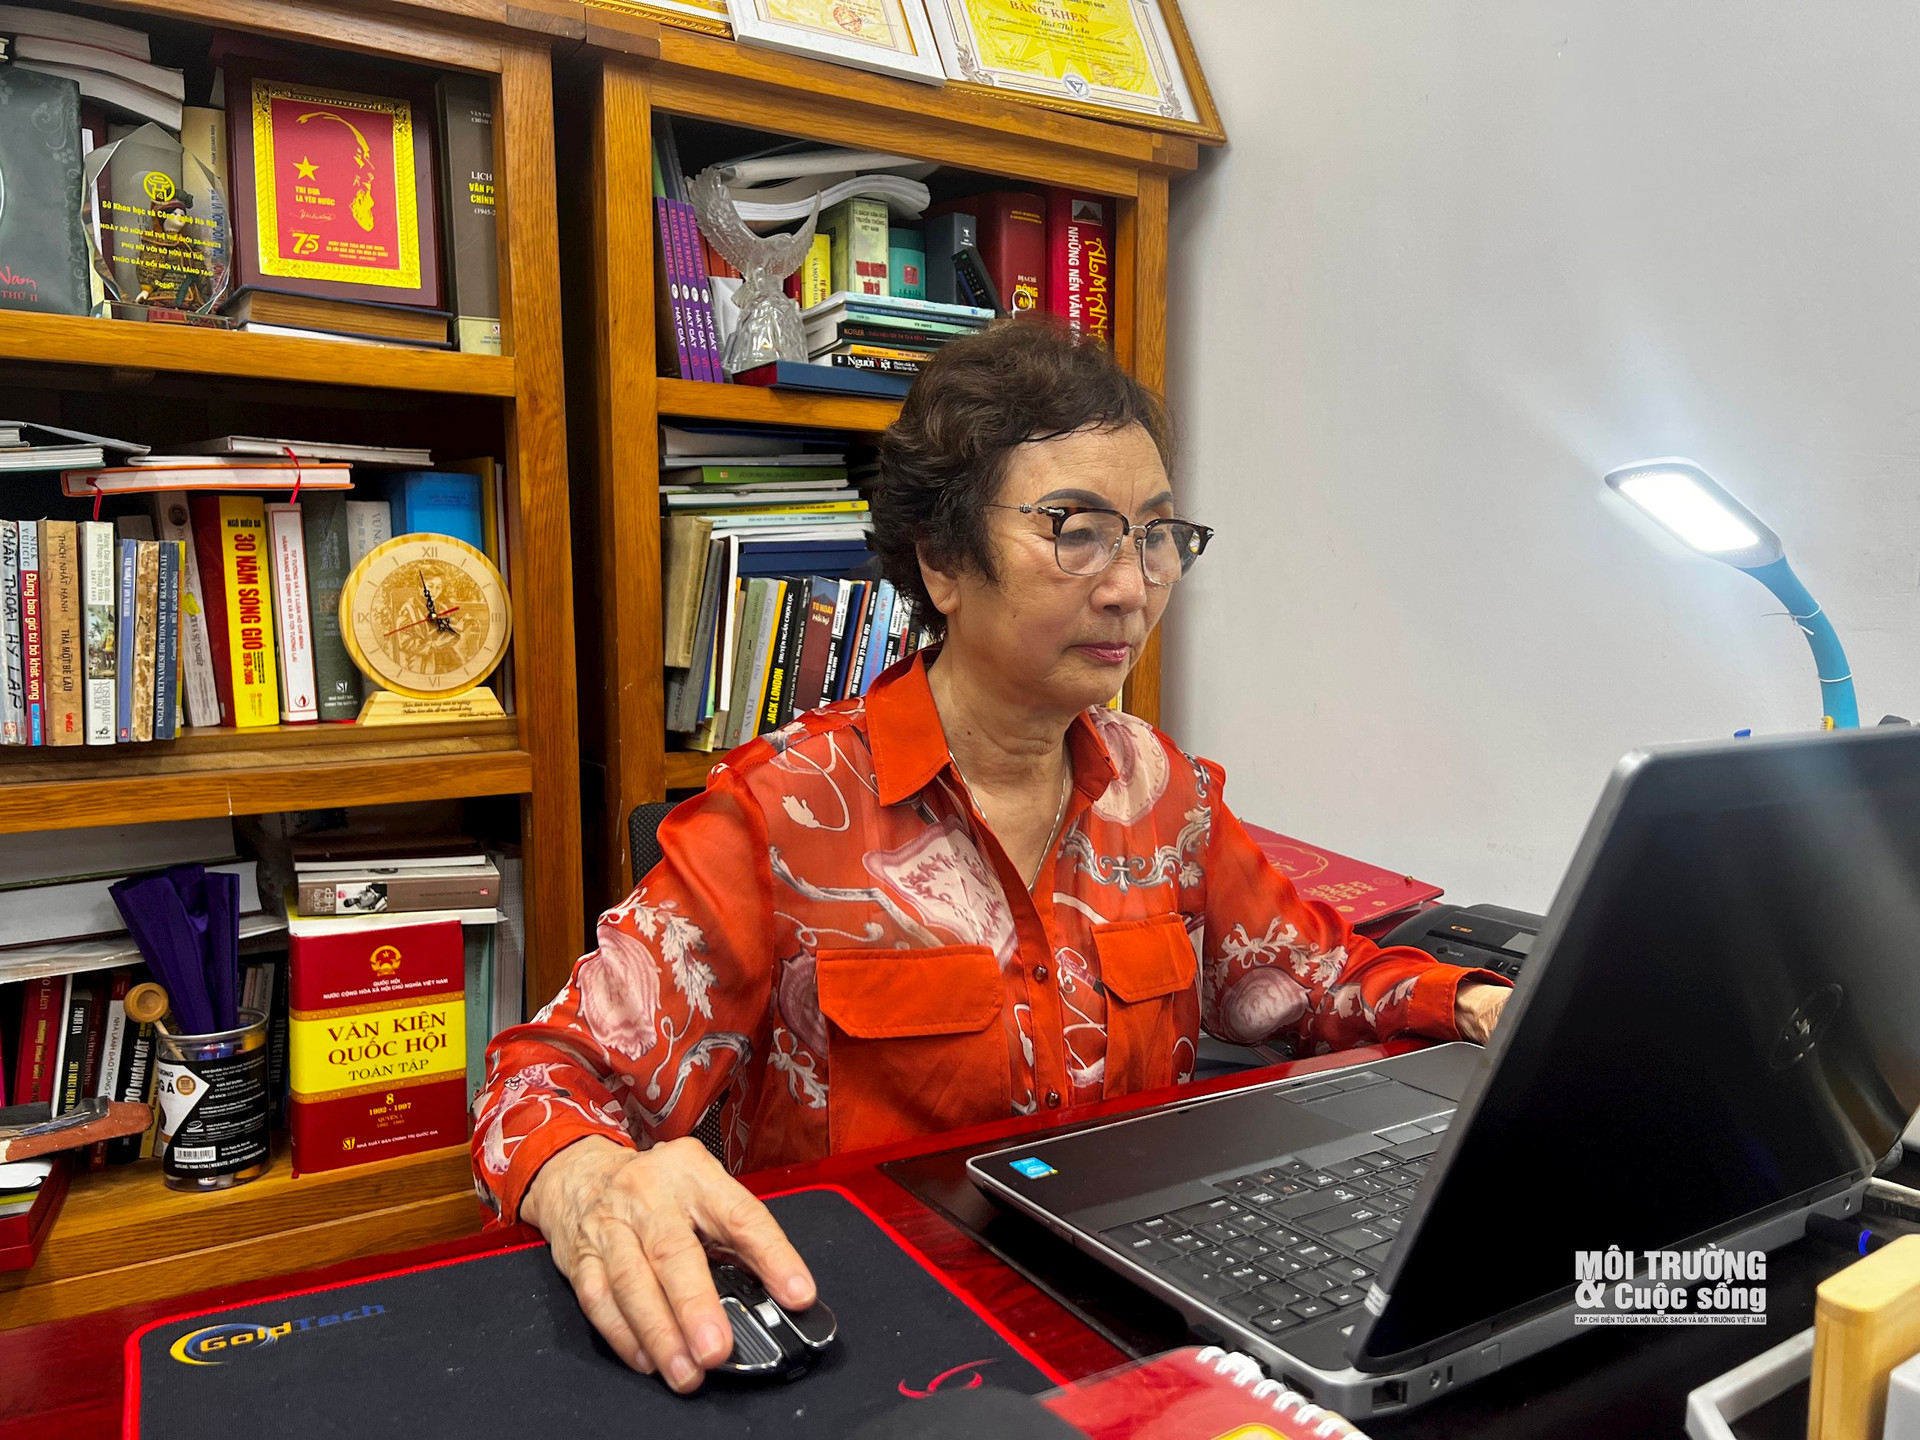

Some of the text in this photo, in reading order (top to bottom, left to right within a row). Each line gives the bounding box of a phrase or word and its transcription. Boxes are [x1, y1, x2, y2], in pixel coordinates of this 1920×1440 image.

[1050, 8, 1089, 23] KHEN
[113, 202, 131, 212] Khoa
[292, 232, 320, 254] 75
[1068, 226, 1082, 266] NHỮNG
[1069, 269, 1084, 291] NỀN
[1069, 294, 1082, 318] VĂN
[677, 328, 686, 348] CÁT
[685, 308, 697, 348] HẠT CÁT
[694, 310, 706, 350] HẠT CÁT
[705, 311, 717, 351] HẠT CÁT
[847, 355, 874, 369] Người
[234, 534, 256, 552] 30
[422, 546, 438, 557] XII
[159, 554, 167, 599] REAL-ESTATE
[236, 555, 262, 585] NĂM
[358, 613, 370, 622] IX
[492, 613, 501, 622] III
[4, 574, 22, 710] THOẠI HY LẠP
[24, 573, 40, 700] Đừng bao giờ từ bỏ khát vọng
[158, 612, 167, 652] DICTIONARY
[241, 625, 267, 650] GIÓ
[778, 641, 787, 664] TRUYỆN
[429, 677, 440, 687] VI
[767, 668, 784, 724] JACK LONDON
[327, 1011, 446, 1042] VĂN KIỆN
[328, 1032, 447, 1066] QUỐC HỘI
[130, 1039, 150, 1087] NHÂN VẬT
[348, 1058, 429, 1081] TOÀN TẬP
[386, 1093, 394, 1105] 8
